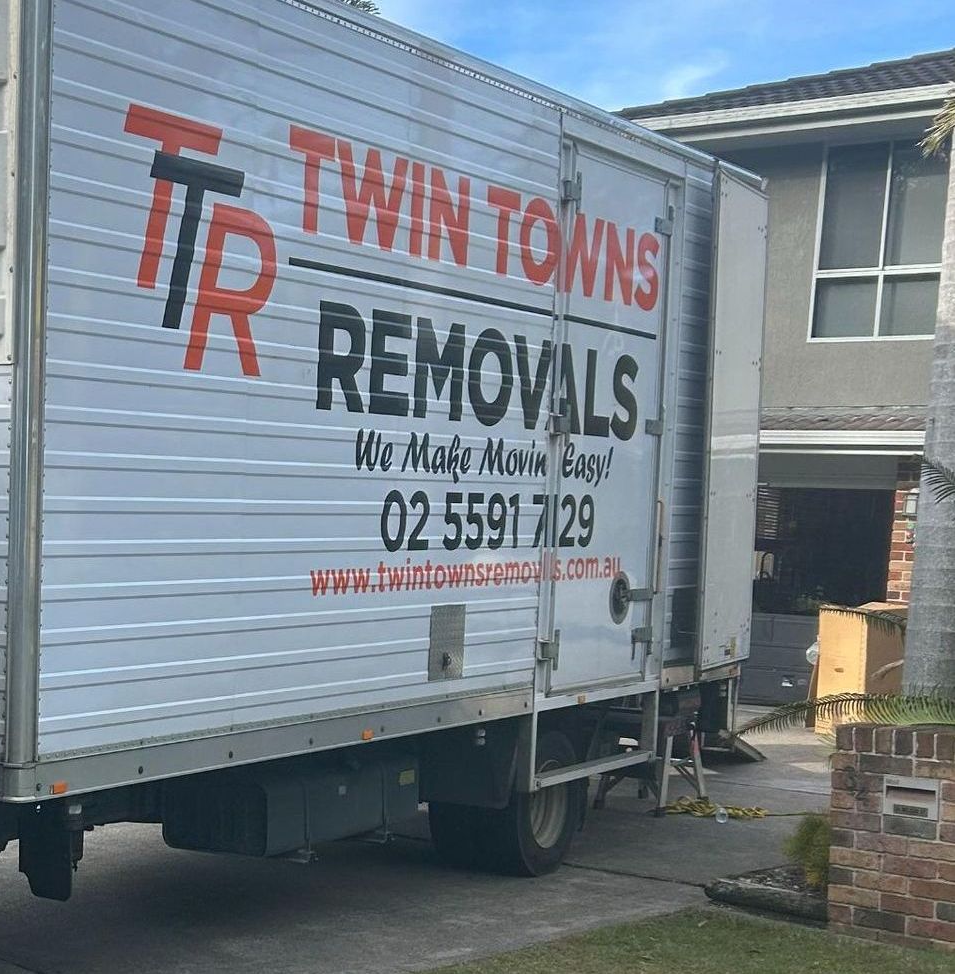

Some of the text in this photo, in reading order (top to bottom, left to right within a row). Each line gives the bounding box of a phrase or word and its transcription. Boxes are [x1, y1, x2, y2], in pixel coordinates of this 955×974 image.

[123, 104, 277, 377] TTR
[289, 124, 660, 312] TWIN TOWNS
[315, 300, 639, 441] REMOVALS
[354, 428, 614, 487] We Make Movin Easy!
[380, 489, 595, 552] 02 5591 7129
